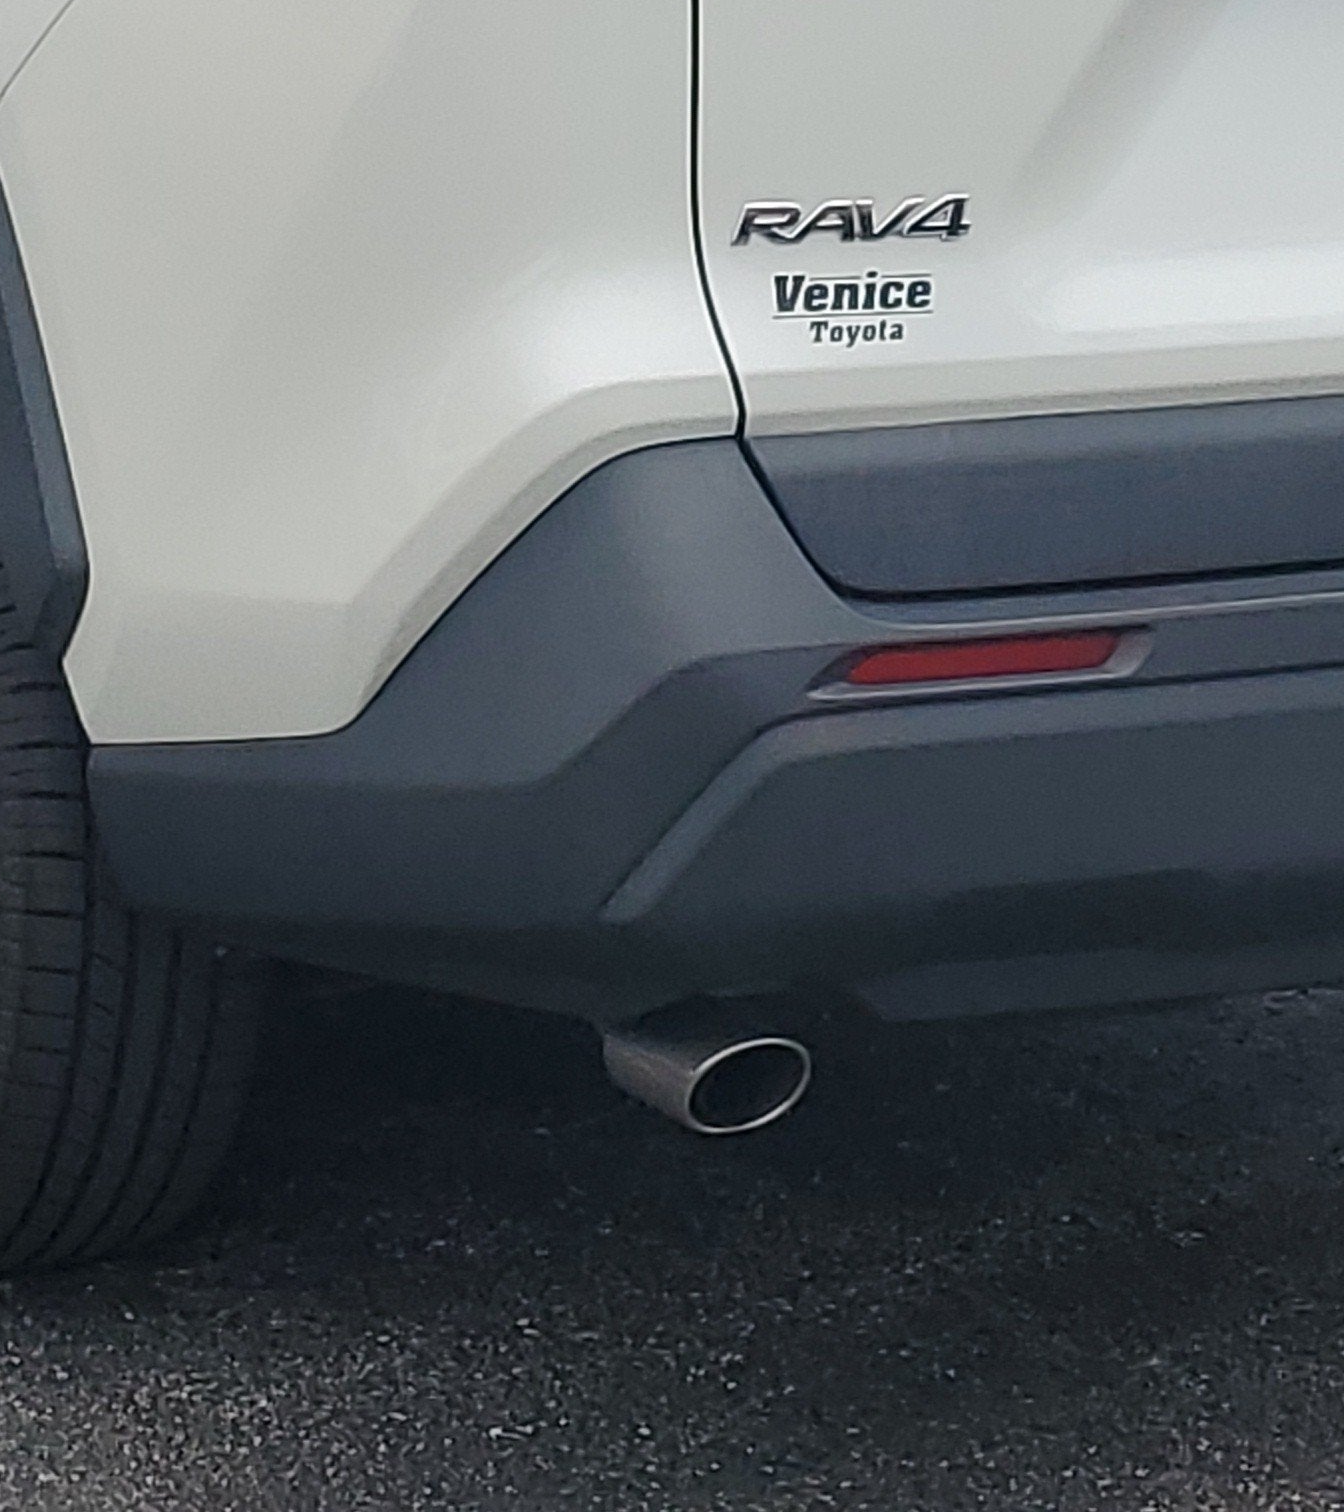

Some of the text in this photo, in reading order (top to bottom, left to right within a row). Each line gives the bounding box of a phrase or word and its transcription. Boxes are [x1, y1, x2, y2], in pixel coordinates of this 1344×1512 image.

[730, 193, 972, 246] RAV4
[773, 271, 932, 313] Venice
[809, 319, 904, 348] Toyota
